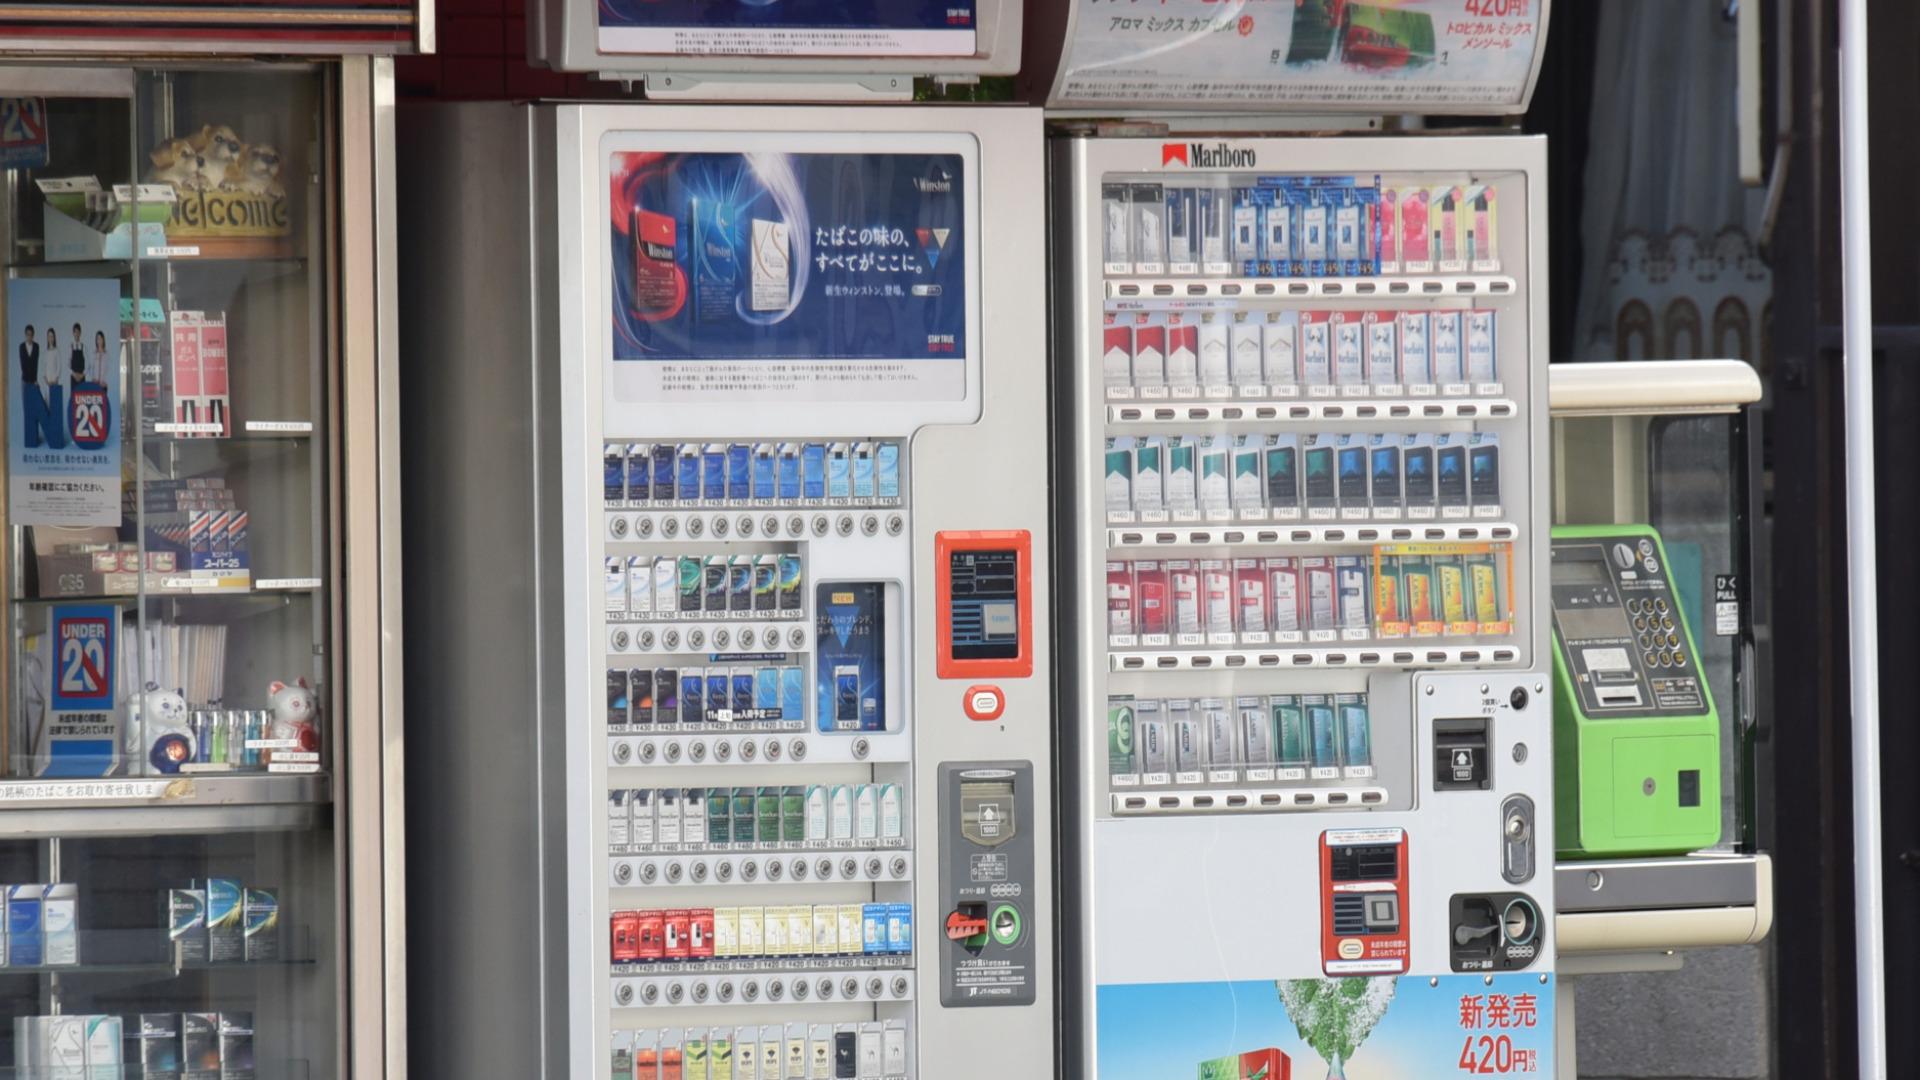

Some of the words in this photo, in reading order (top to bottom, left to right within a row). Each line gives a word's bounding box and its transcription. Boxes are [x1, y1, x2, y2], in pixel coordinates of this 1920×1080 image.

[1109, 16, 1146, 32] アロマ
[1147, 16, 1184, 32] ミックス
[1446, 22, 1496, 35] トロピカル
[1498, 22, 1532, 34] ミックス
[1462, 38, 1512, 49] メンソール
[1190, 143, 1256, 168] Marlboro
[914, 178, 951, 192] Winston
[815, 225, 910, 248] たばこの味の、
[648, 242, 674, 259] Winston
[815, 252, 923, 274] すべてがここに。
[75, 394, 104, 405] UNDER
[75, 404, 104, 437] 20
[1717, 577, 1737, 588] ひく
[1717, 591, 1737, 600] PULL
[62, 623, 106, 638] UNDER
[62, 638, 105, 691] 20
[969, 987, 978, 997] JT
[1459, 993, 1537, 1029] 新発売
[1459, 1035, 1528, 1074] 420円
[1528, 1050, 1537, 1072] 税込
